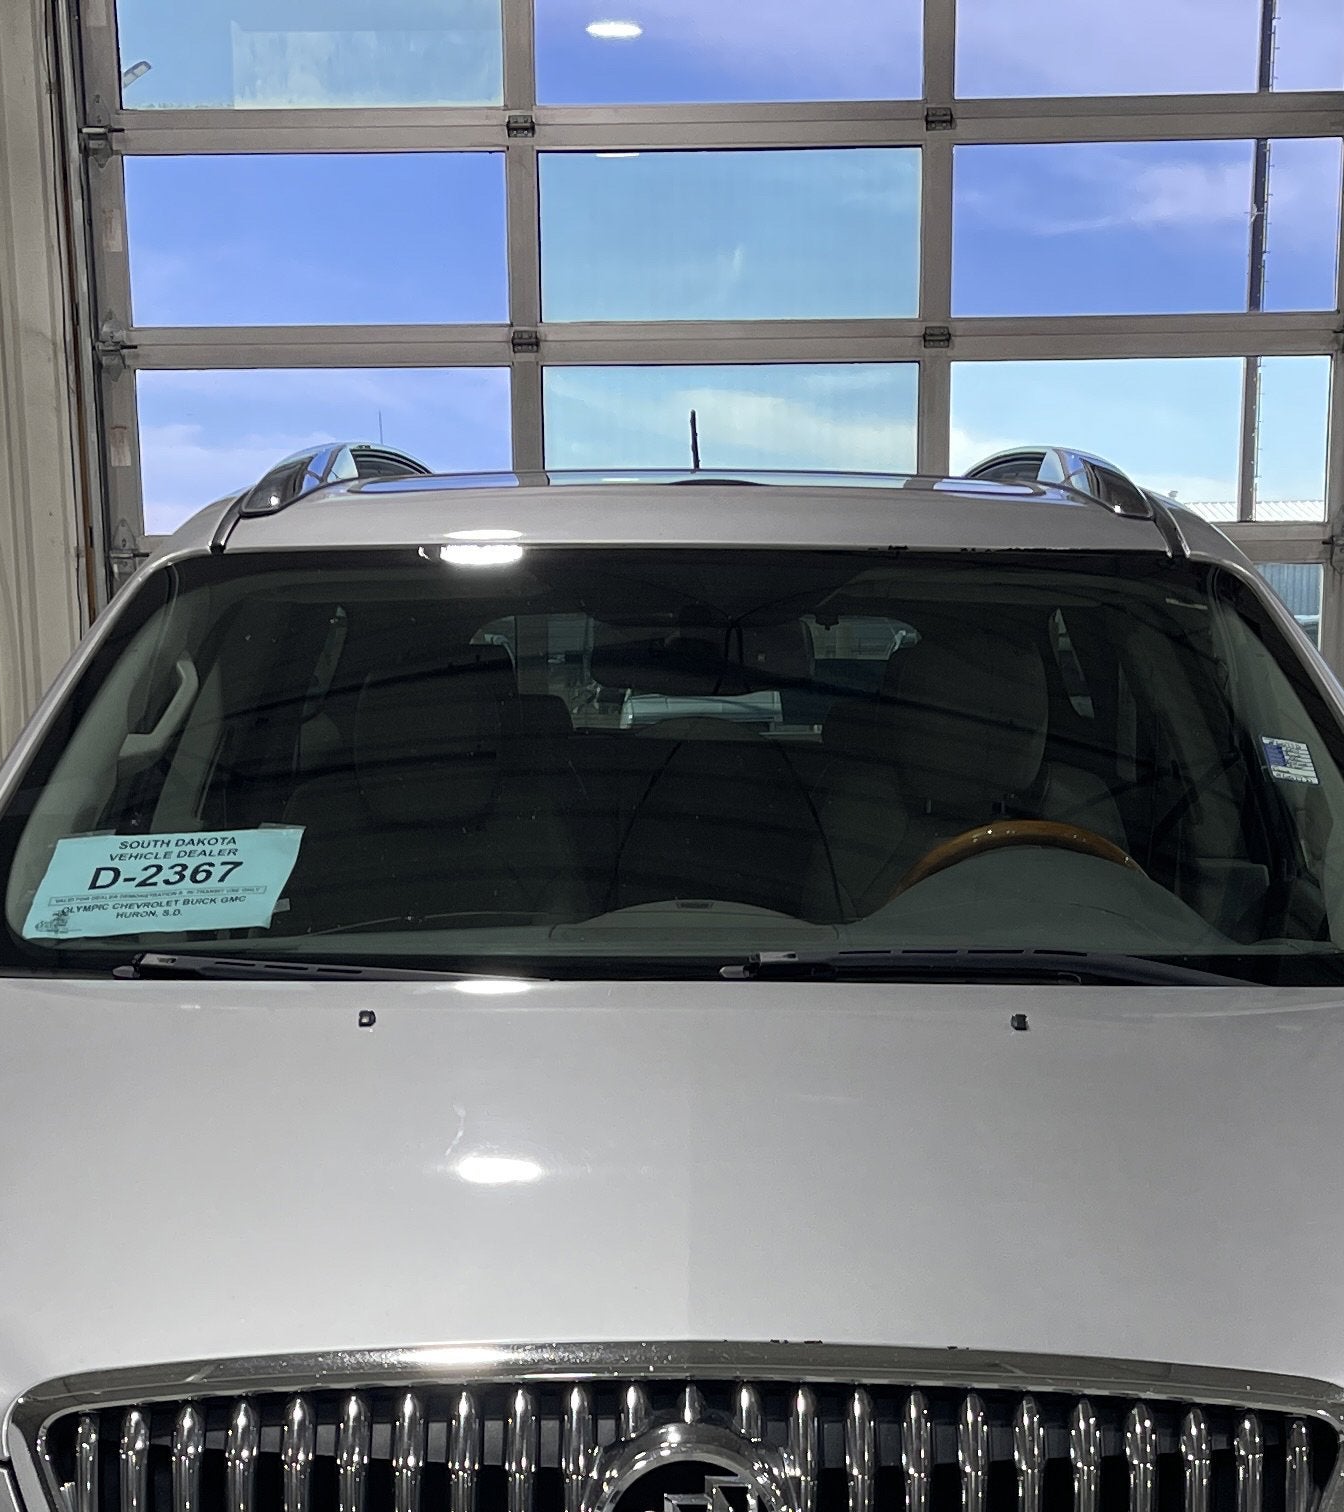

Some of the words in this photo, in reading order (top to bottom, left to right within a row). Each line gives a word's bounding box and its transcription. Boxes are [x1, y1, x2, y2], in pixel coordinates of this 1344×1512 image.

[118, 838, 171, 850] SOUTH
[175, 836, 237, 848] DAKOTA
[109, 850, 172, 862] VEHICLE
[176, 848, 239, 859] DEALER
[88, 861, 243, 890] D-2367
[62, 903, 109, 915] OLYMPIC
[112, 899, 179, 910] CHEVROLET
[182, 897, 217, 906] BUICK
[220, 895, 247, 904] GMC
